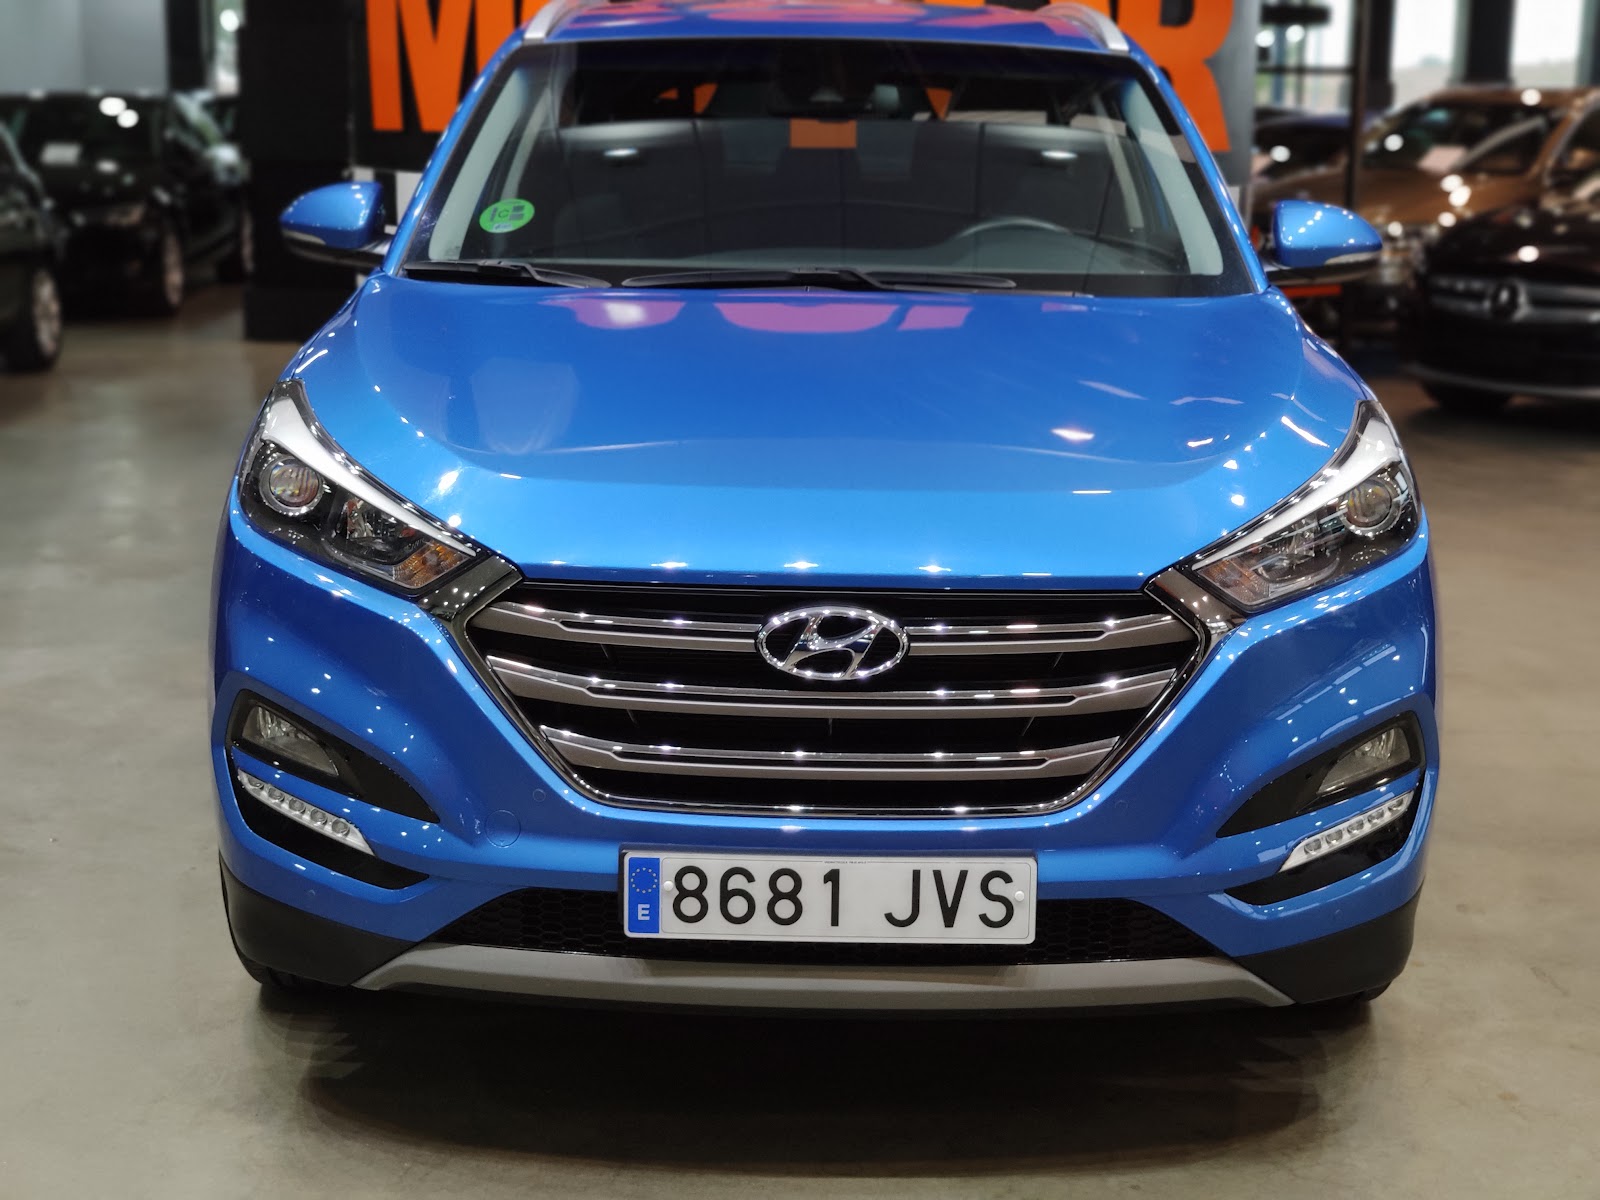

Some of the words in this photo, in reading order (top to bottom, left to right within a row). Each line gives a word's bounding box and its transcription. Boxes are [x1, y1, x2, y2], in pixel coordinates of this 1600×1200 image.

[637, 903, 651, 921] E
[672, 865, 841, 927] 8681
[884, 869, 1015, 929] JVS
